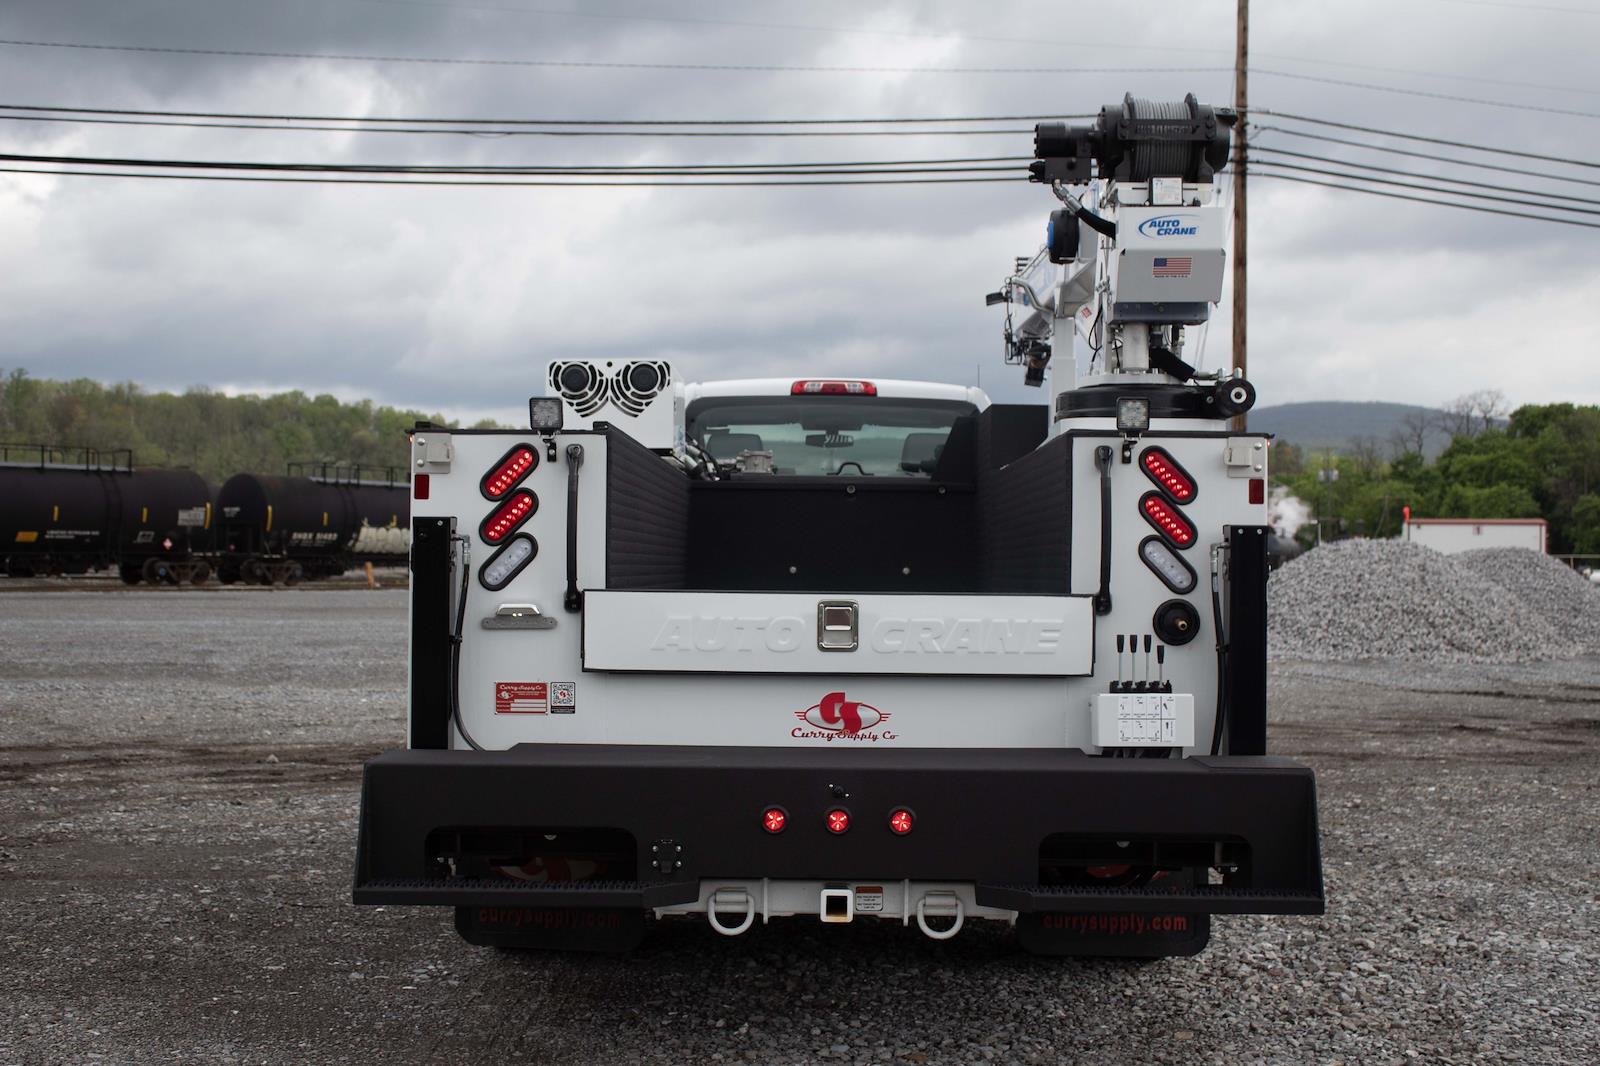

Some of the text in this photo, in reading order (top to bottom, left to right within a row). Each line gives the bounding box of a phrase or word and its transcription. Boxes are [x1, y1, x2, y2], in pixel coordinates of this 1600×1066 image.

[1149, 219, 1180, 228] AUTO
[1157, 227, 1197, 236] CRANE
[649, 615, 1065, 655] AUTO CRANE
[791, 728, 835, 741] Curry
[835, 729, 879, 742] Supply
[479, 908, 621, 929] currysupply.com
[1042, 912, 1187, 935] currysupply.com
